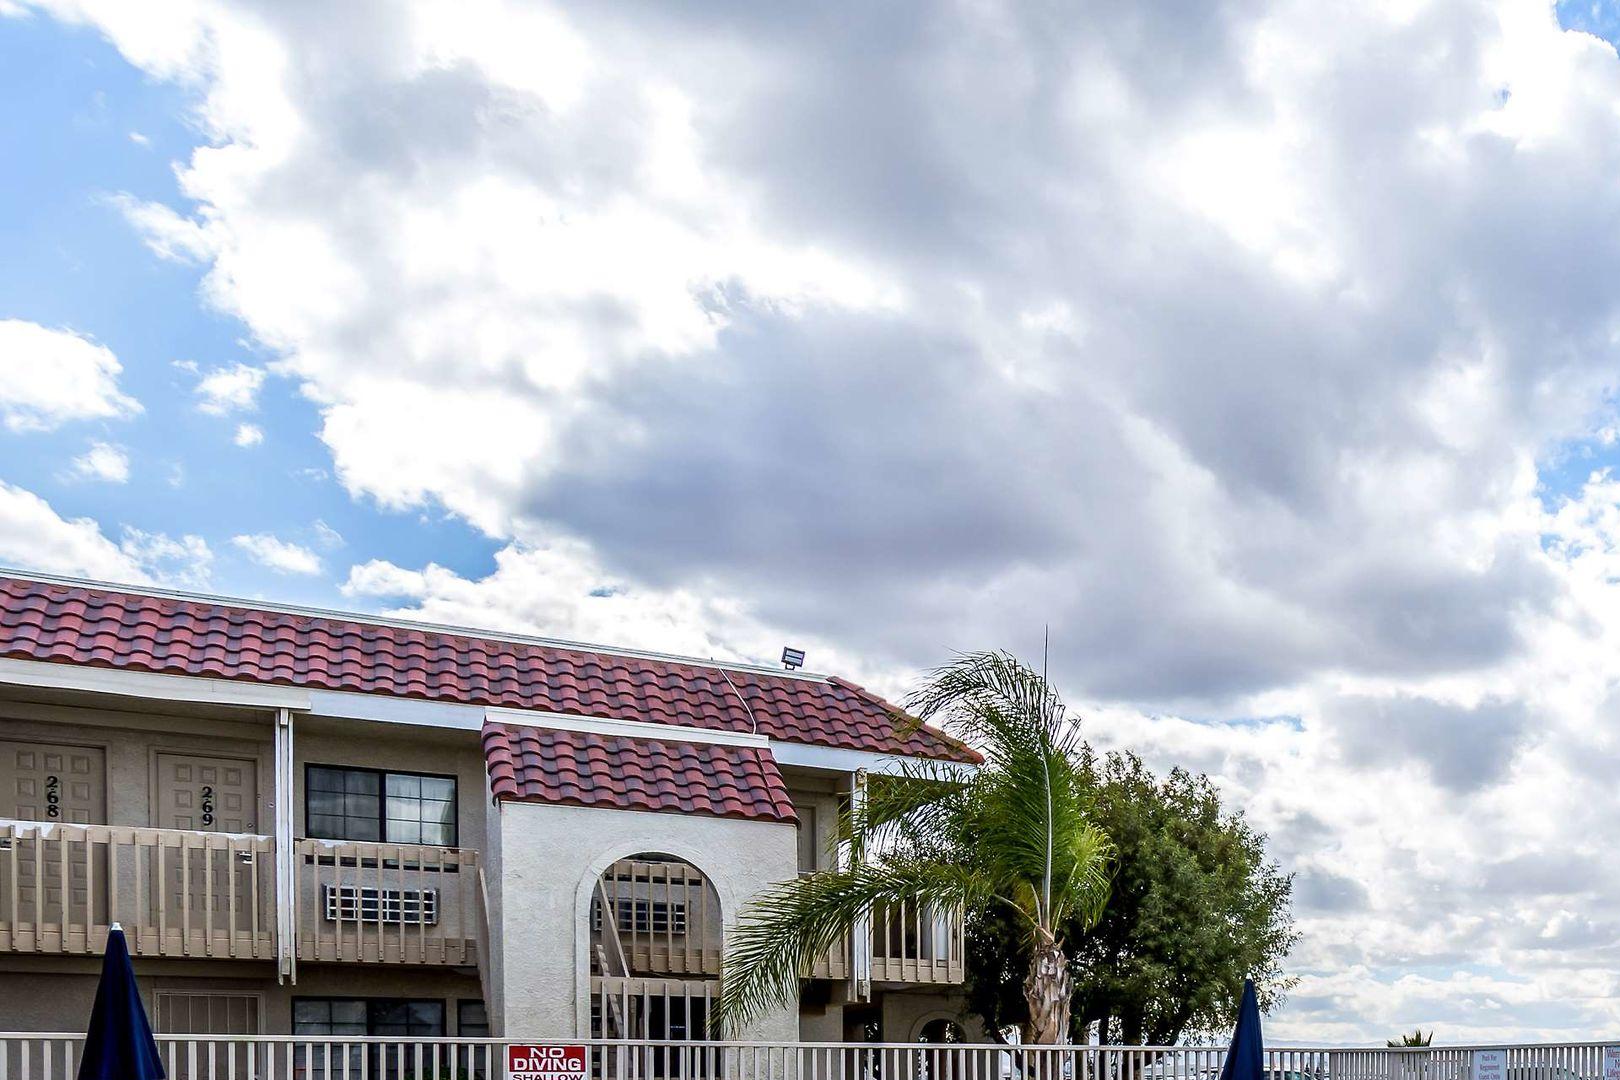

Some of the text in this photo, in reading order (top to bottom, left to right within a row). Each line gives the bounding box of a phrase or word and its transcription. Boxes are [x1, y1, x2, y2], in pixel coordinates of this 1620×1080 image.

[46, 775, 59, 818] 268
[202, 786, 213, 826] 269
[513, 1058, 582, 1071] DIVING
[530, 1047, 565, 1058] NO
